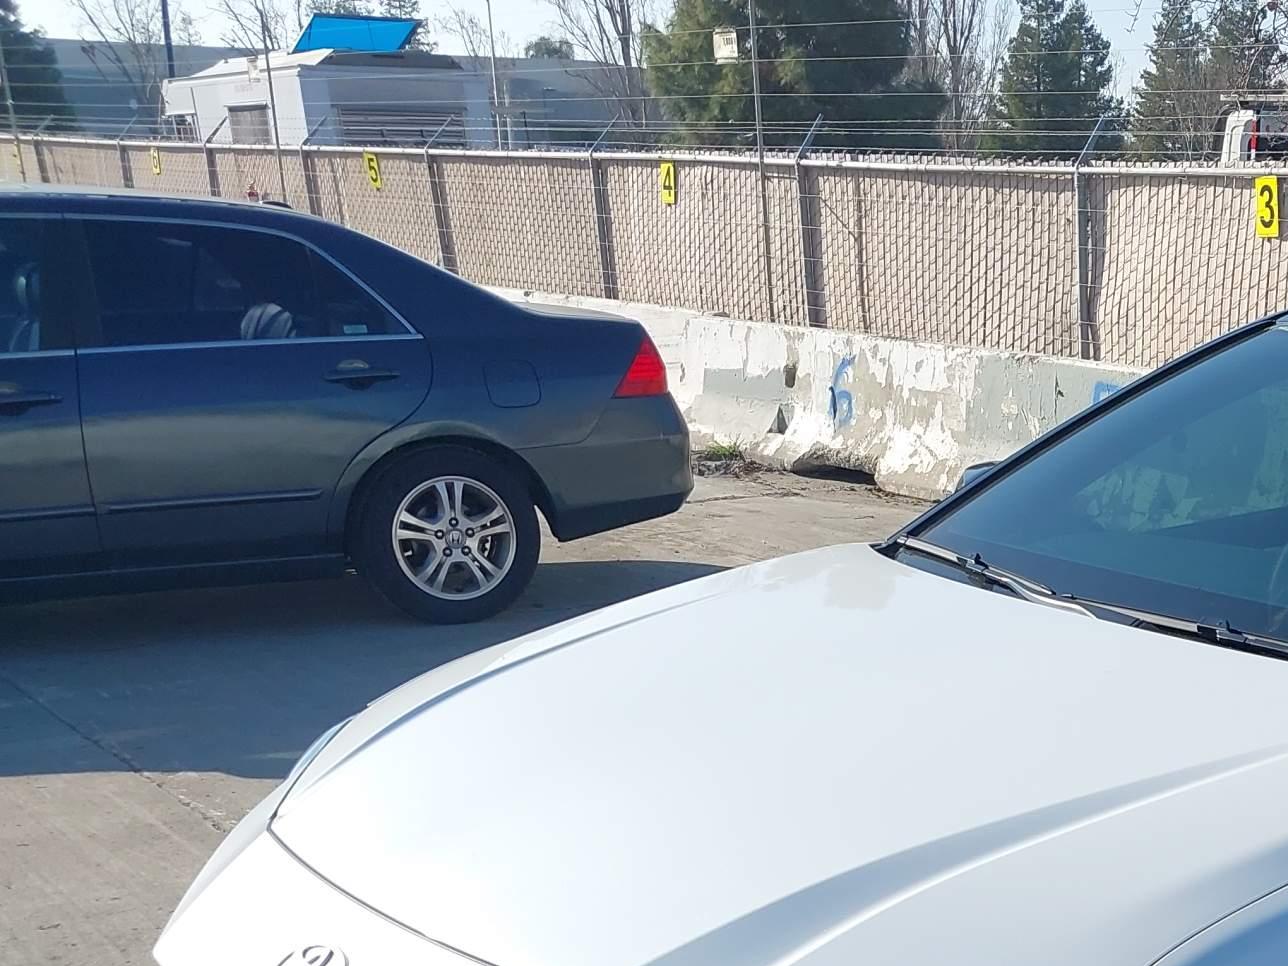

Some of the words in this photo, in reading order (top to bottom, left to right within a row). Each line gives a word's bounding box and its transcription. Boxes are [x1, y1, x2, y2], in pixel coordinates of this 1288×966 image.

[367, 157, 378, 183] 5
[663, 165, 673, 197] 4
[1259, 184, 1275, 229] 3
